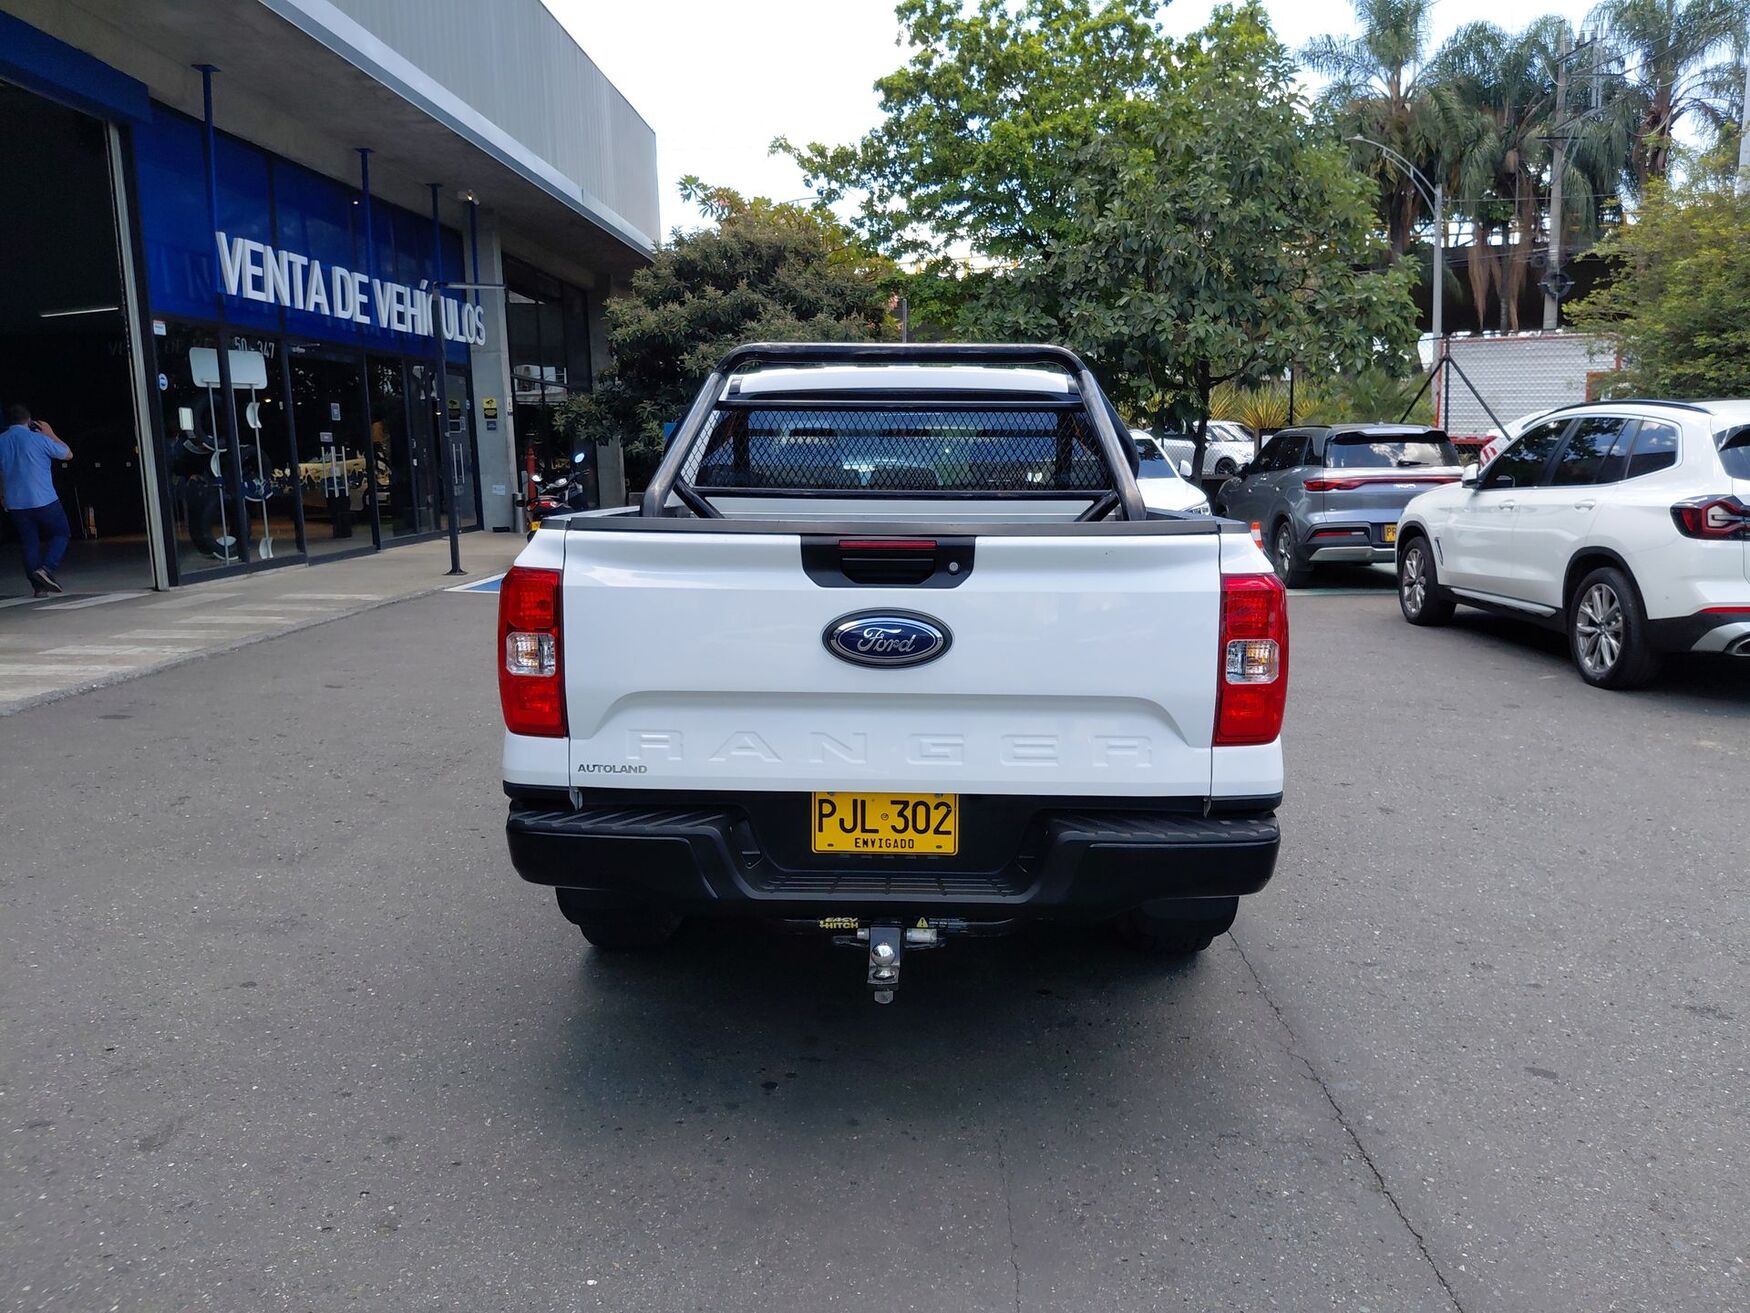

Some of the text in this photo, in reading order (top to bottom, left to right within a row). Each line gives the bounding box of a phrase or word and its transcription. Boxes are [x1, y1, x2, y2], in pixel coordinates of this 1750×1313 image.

[215, 231, 330, 315] VENTA
[331, 265, 371, 325] DE
[857, 627, 916, 652] Ford
[626, 729, 1152, 768] RANGER
[577, 764, 648, 774] AUTOLAND
[817, 798, 952, 835] PJL 302
[854, 837, 915, 849] ENVIGADO
